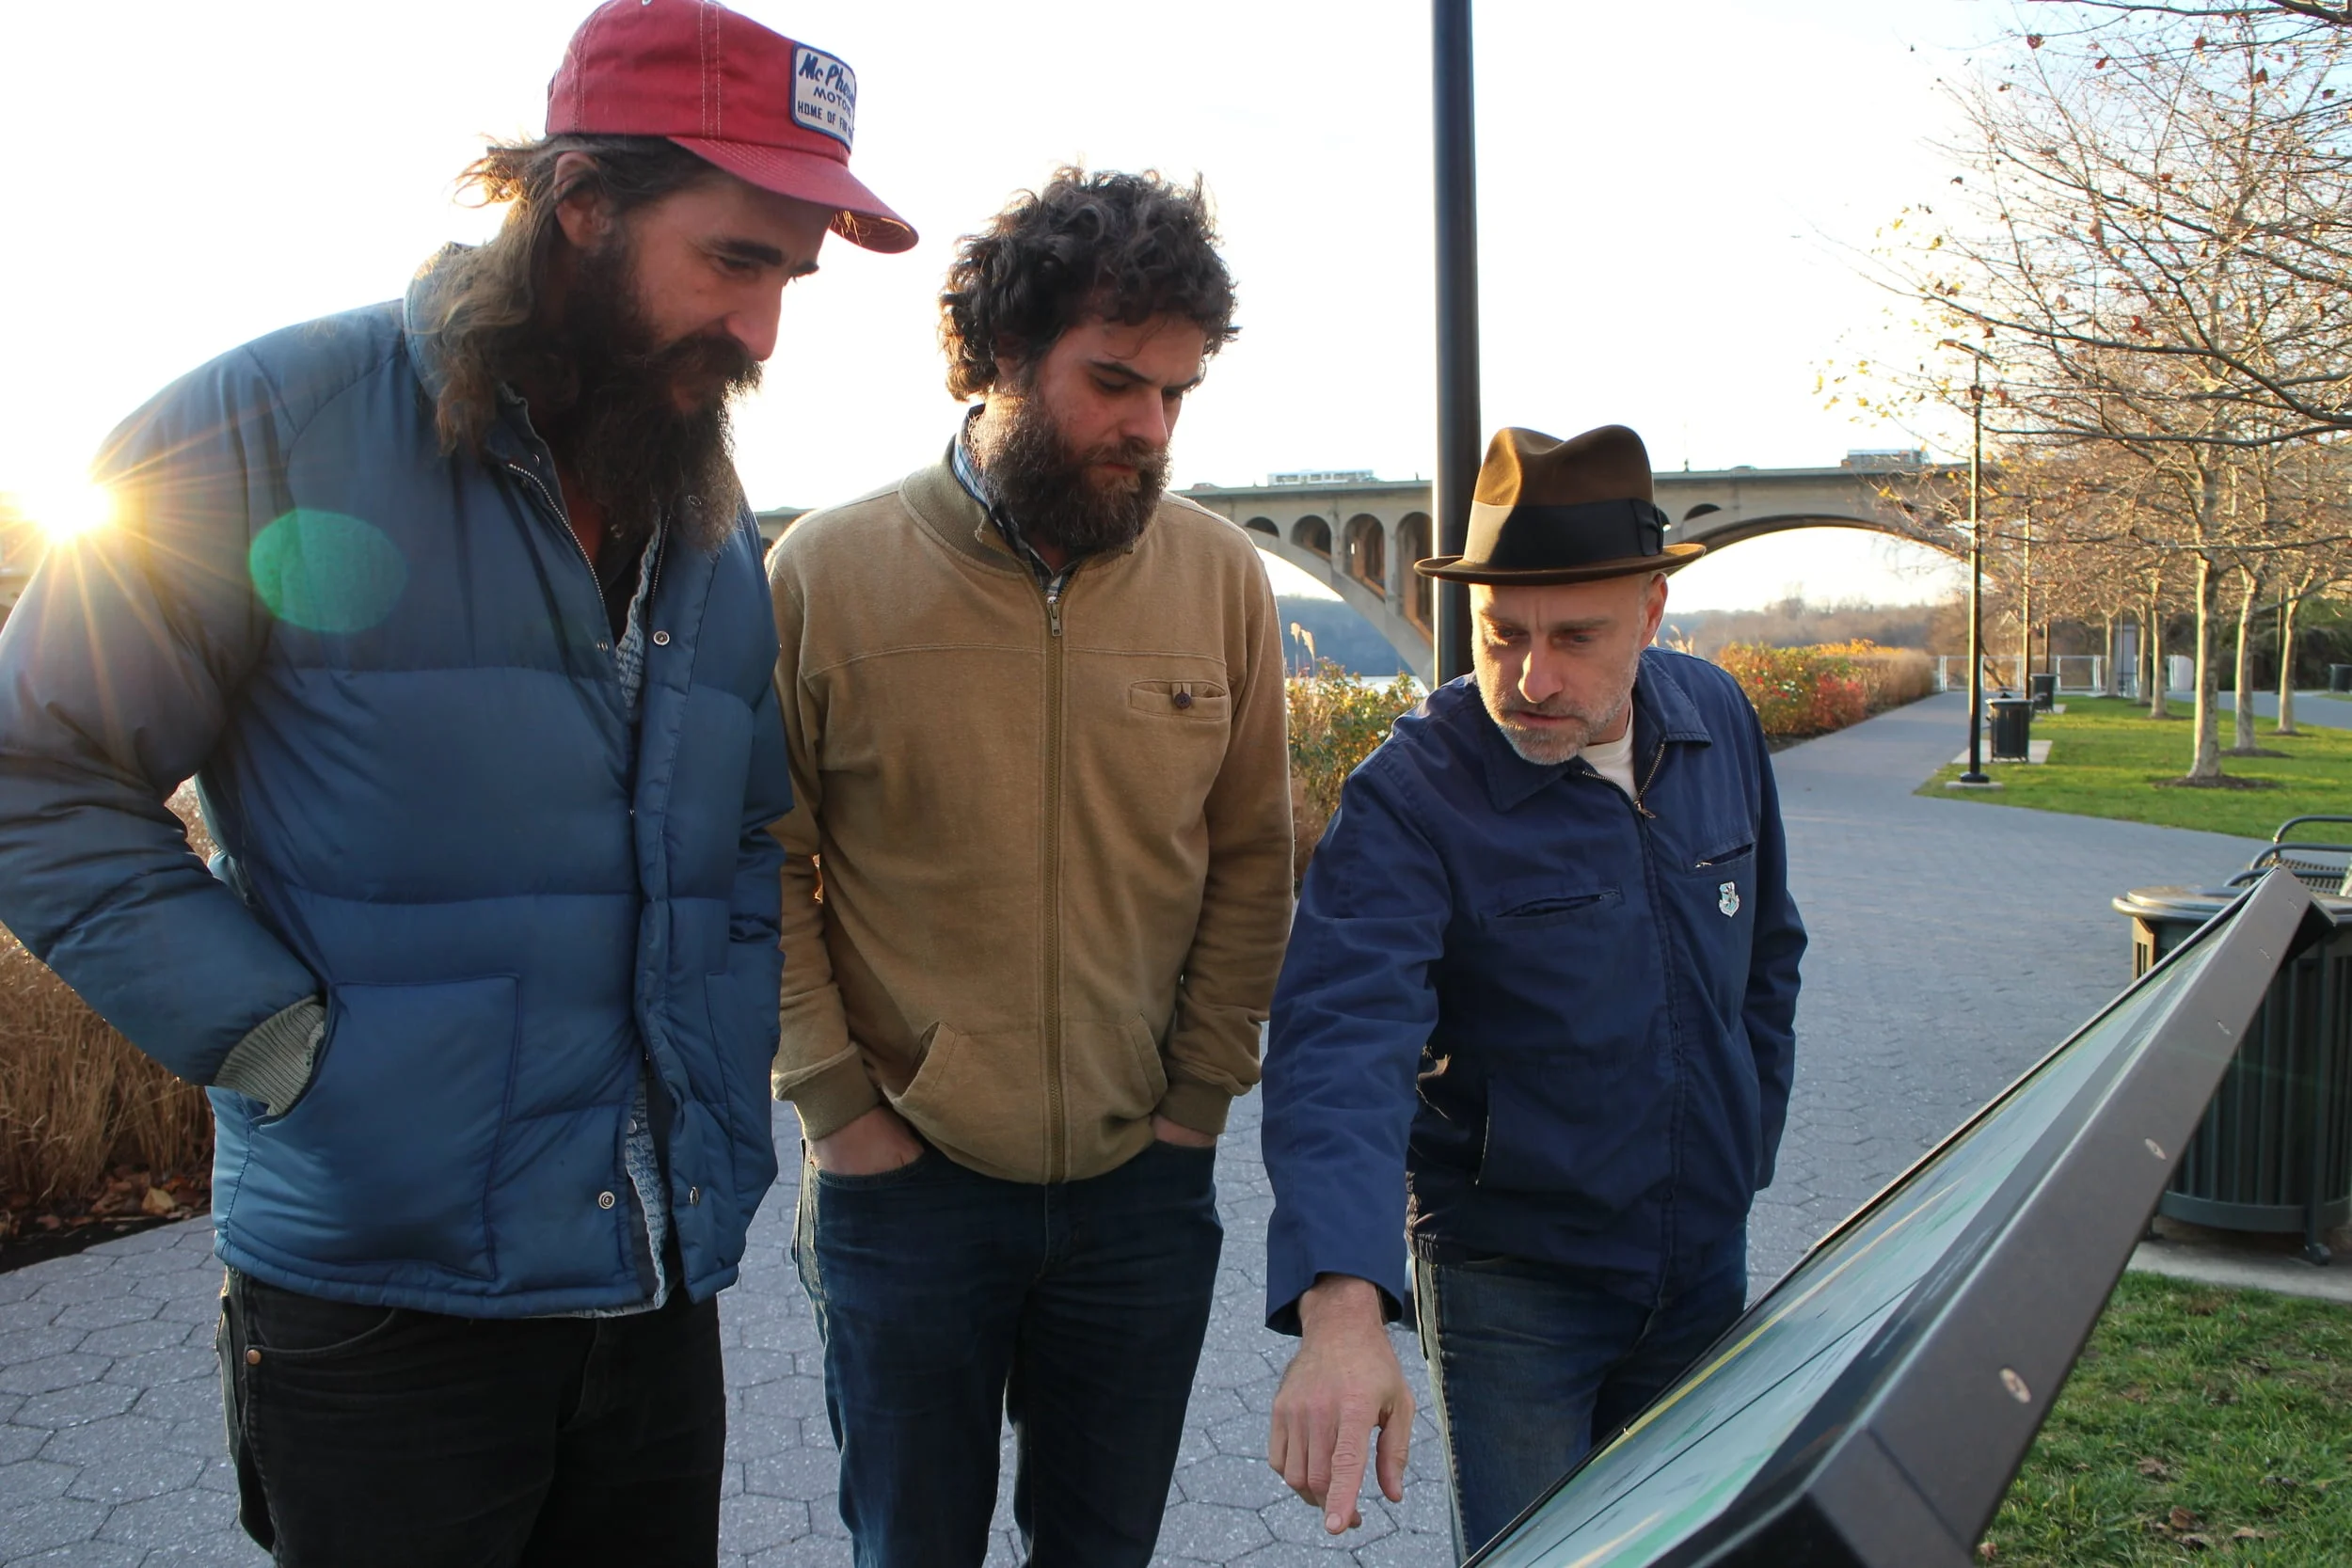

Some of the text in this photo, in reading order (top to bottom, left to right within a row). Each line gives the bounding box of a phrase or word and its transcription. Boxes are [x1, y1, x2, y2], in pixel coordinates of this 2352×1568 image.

[798, 100, 822, 120] HOME
[827, 111, 836, 125] OF
[813, 86, 851, 119] MOTO
